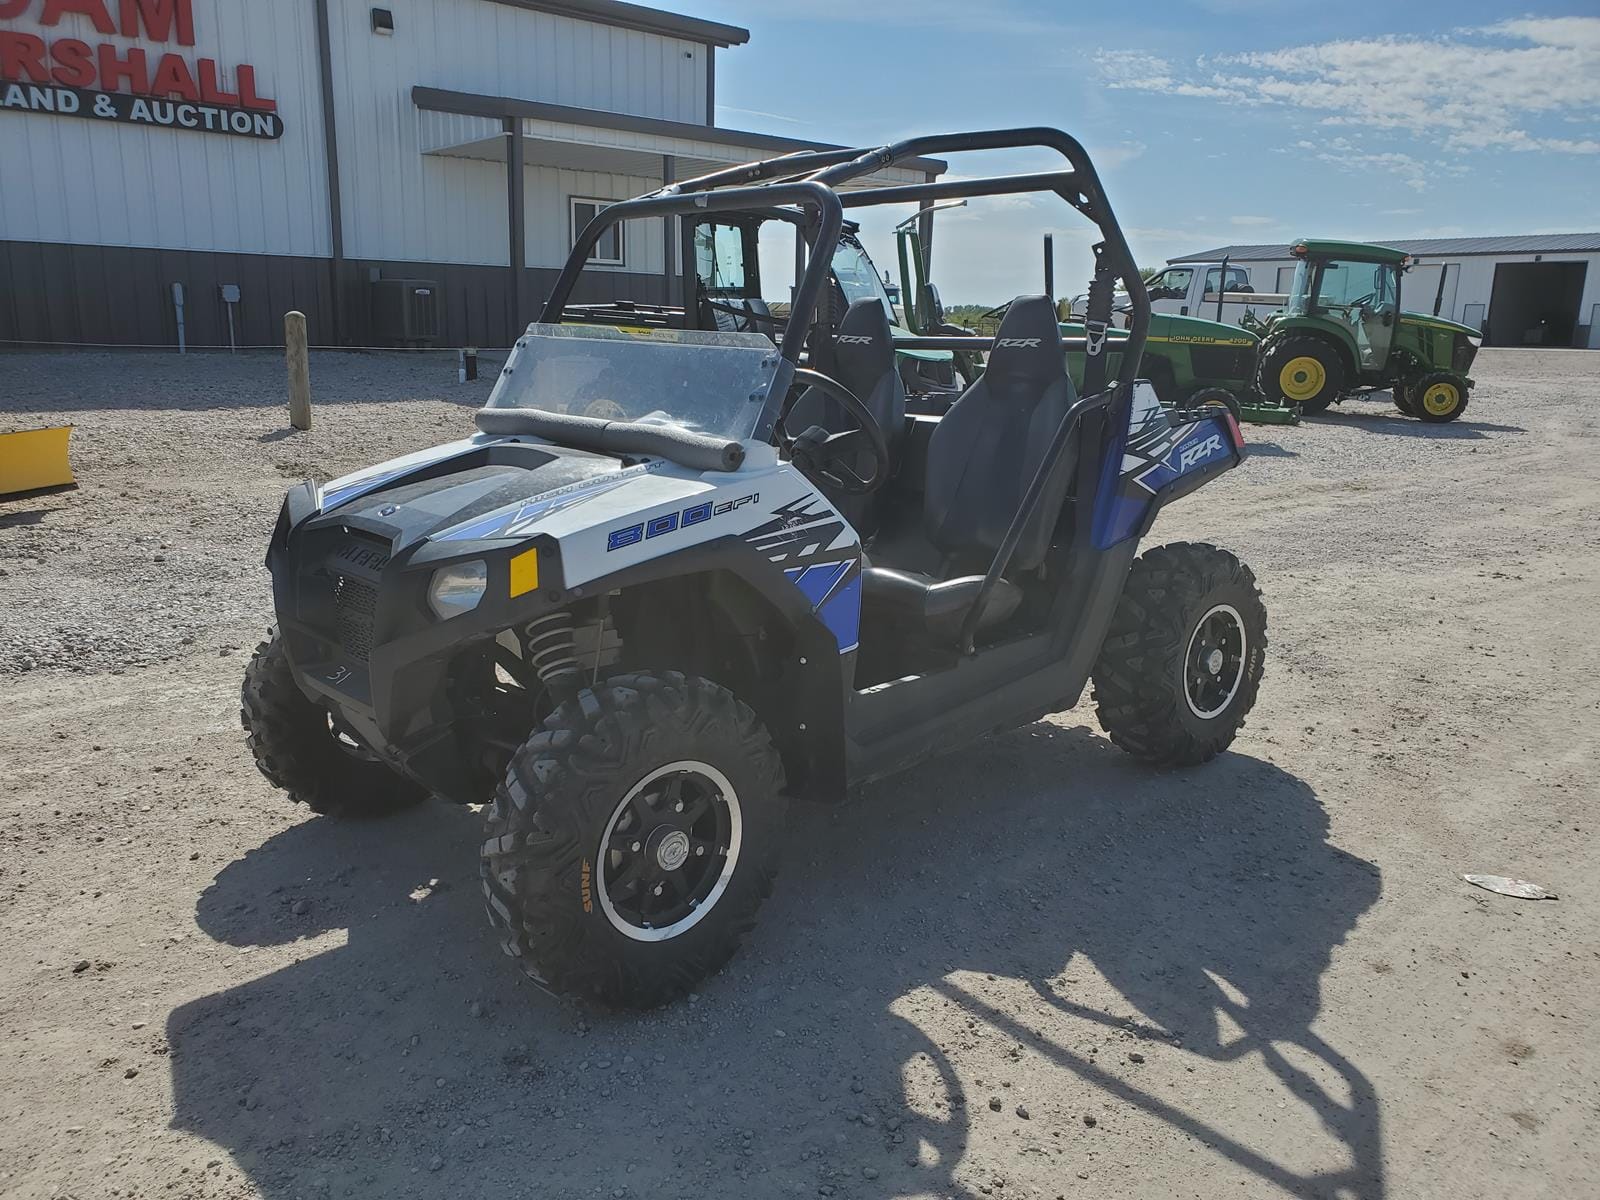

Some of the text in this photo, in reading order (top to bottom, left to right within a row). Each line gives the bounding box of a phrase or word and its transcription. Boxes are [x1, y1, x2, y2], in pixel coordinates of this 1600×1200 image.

[0, 31, 277, 111] RSHALL
[0, 84, 275, 137] AND & AUCTION
[837, 335, 873, 345] RZR
[996, 338, 1042, 348] RZR
[1180, 434, 1223, 474] RZR
[607, 501, 714, 552] 800
